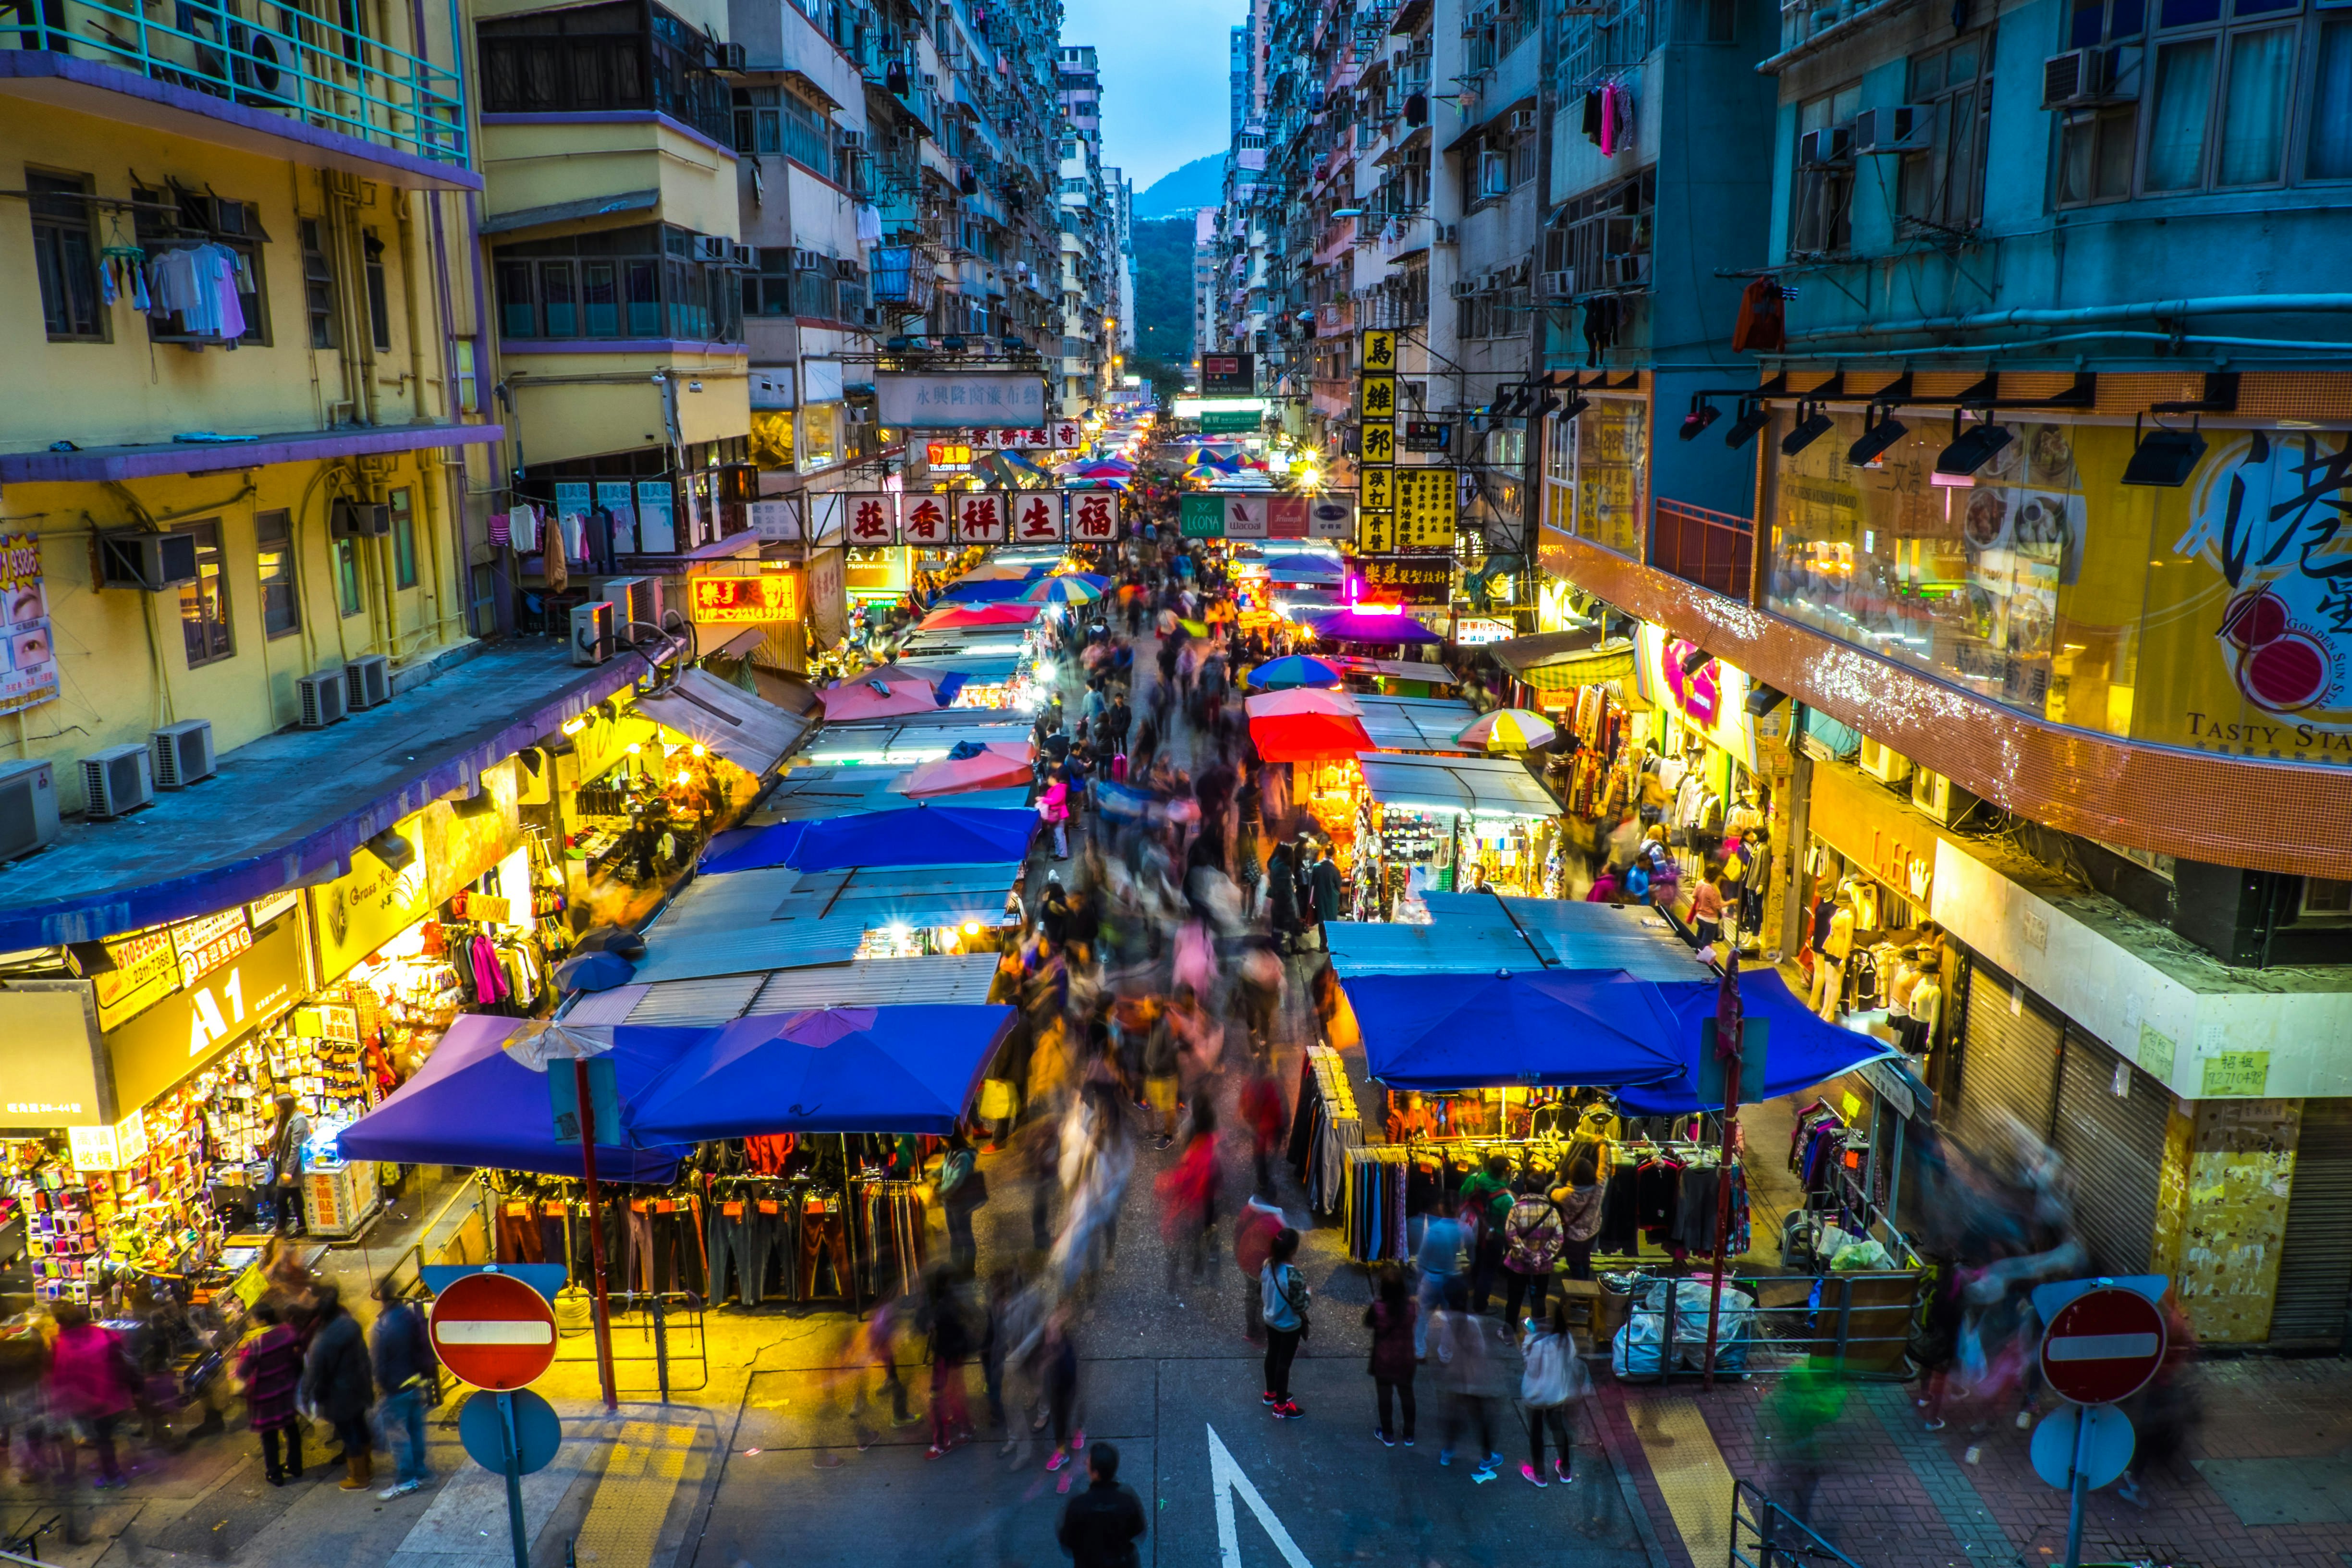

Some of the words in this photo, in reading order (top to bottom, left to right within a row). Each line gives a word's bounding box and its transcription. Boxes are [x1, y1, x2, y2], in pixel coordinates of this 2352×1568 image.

[1838, 493, 1857, 509] FOOD
[1230, 522, 1261, 530] Wacoal
[1274, 514, 1302, 523] Triumph
[2286, 618, 2339, 651] GOLDEN
[2333, 652, 2346, 680] SUN
[2315, 683, 2345, 711] STAR
[2187, 712, 2281, 744] TASTY
[350, 886, 377, 906] Grass
[133, 951, 170, 984] 2311-7368
[189, 967, 245, 1057] A1
[2221, 1055, 2255, 1070] 招租
